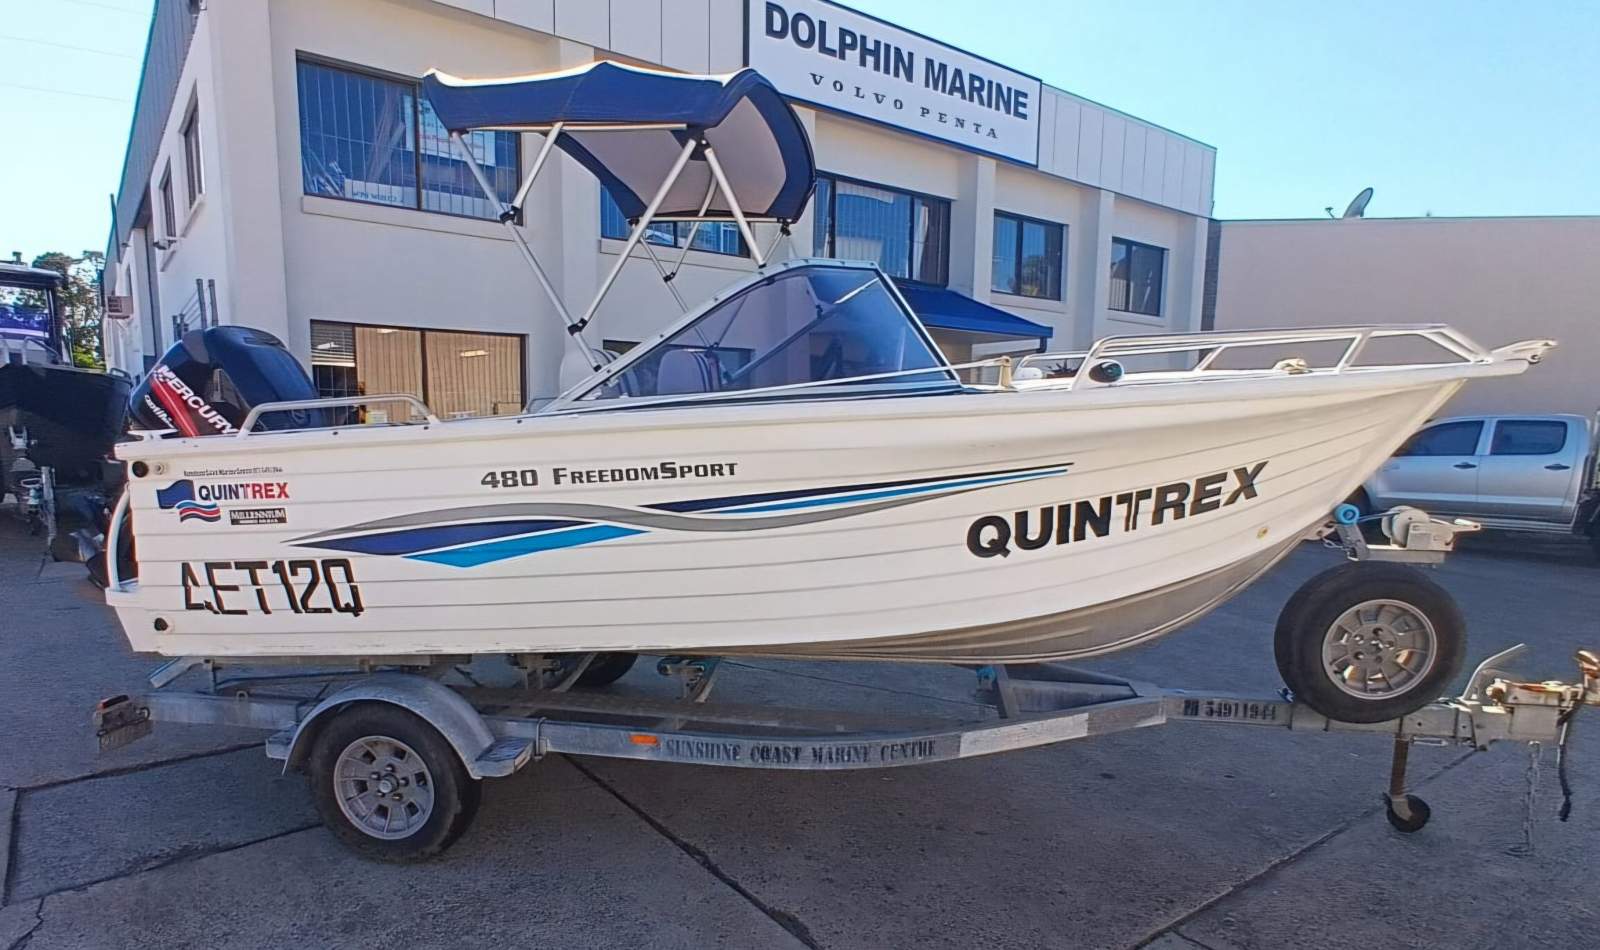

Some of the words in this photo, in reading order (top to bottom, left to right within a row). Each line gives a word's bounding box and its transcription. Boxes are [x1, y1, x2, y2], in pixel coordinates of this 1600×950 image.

[765, 1, 914, 84] DOLPHIN
[924, 57, 1028, 120] MARINE
[809, 72, 904, 110] VOLVO
[920, 106, 998, 139] PENTA
[154, 364, 241, 434] MERCURY
[198, 482, 290, 501] QUINTREX
[480, 469, 539, 489] 480
[966, 460, 1269, 558] QUINTREX
[181, 558, 364, 617] AET12Q
[666, 739, 741, 761] SUNSHINE
[750, 745, 800, 764] COAST
[811, 746, 872, 764] MARINE
